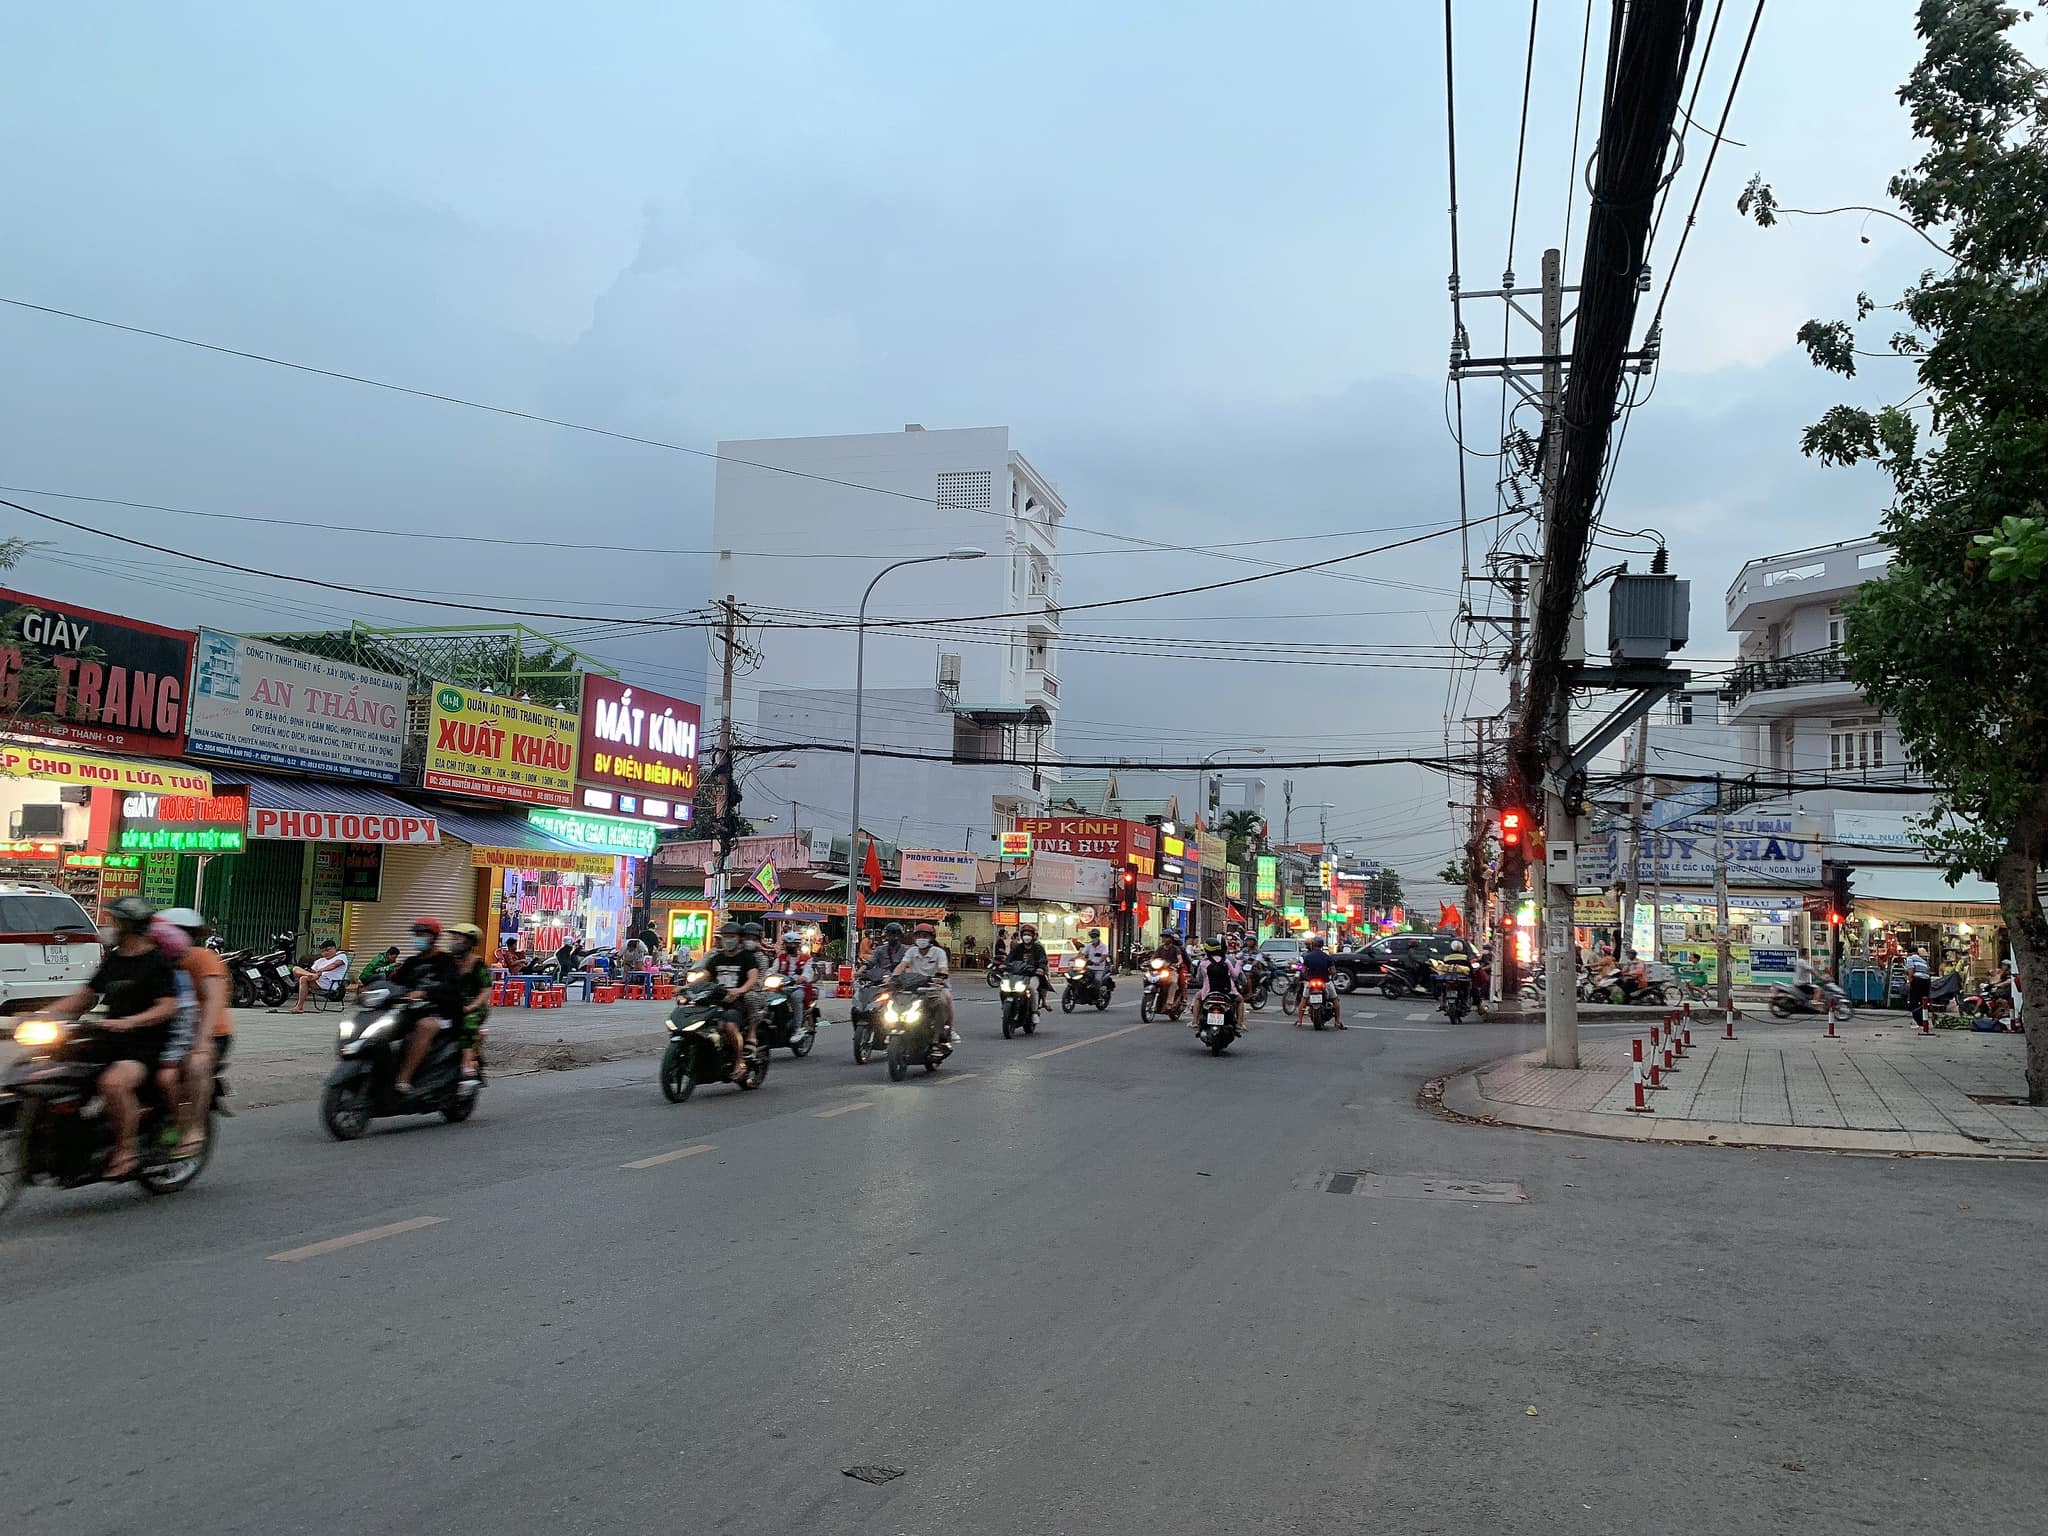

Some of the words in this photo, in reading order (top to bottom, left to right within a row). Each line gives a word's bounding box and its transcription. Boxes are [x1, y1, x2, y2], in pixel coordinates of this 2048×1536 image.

[23, 612, 89, 651] GIÀY
[265, 651, 274, 661] TY
[275, 654, 292, 668] TNHH
[53, 654, 181, 735] TRANG
[250, 676, 297, 709] AN
[304, 683, 398, 730] THẮNG
[519, 709, 542, 726] TRANG
[543, 713, 558, 730] VIỆT
[559, 719, 575, 733] NAM
[594, 687, 645, 748] MẮT
[648, 707, 697, 760] KÍNH
[436, 717, 507, 760] XUẤT
[511, 729, 572, 772] KHẨU
[27, 757, 72, 775] CHO
[79, 764, 119, 783] MỌI
[125, 768, 163, 787] LỨA
[168, 774, 208, 792] TUỔI
[593, 752, 612, 774] BV
[613, 754, 643, 783] ĐIỆN
[643, 760, 672, 785] BIÊN
[671, 764, 694, 790] PHỦ
[122, 791, 158, 818] GIÀY
[197, 795, 243, 821] TRANG
[1503, 814, 1519, 828] 22
[256, 808, 436, 842] PHOTOCOPY
[1023, 818, 1053, 834] ÉP
[1060, 819, 1119, 835] KÍNH
[1757, 816, 1793, 832] NHÂN
[1031, 838, 1072, 852] INH
[1078, 839, 1120, 853] HUY
[1712, 833, 1806, 862] CHÂU
